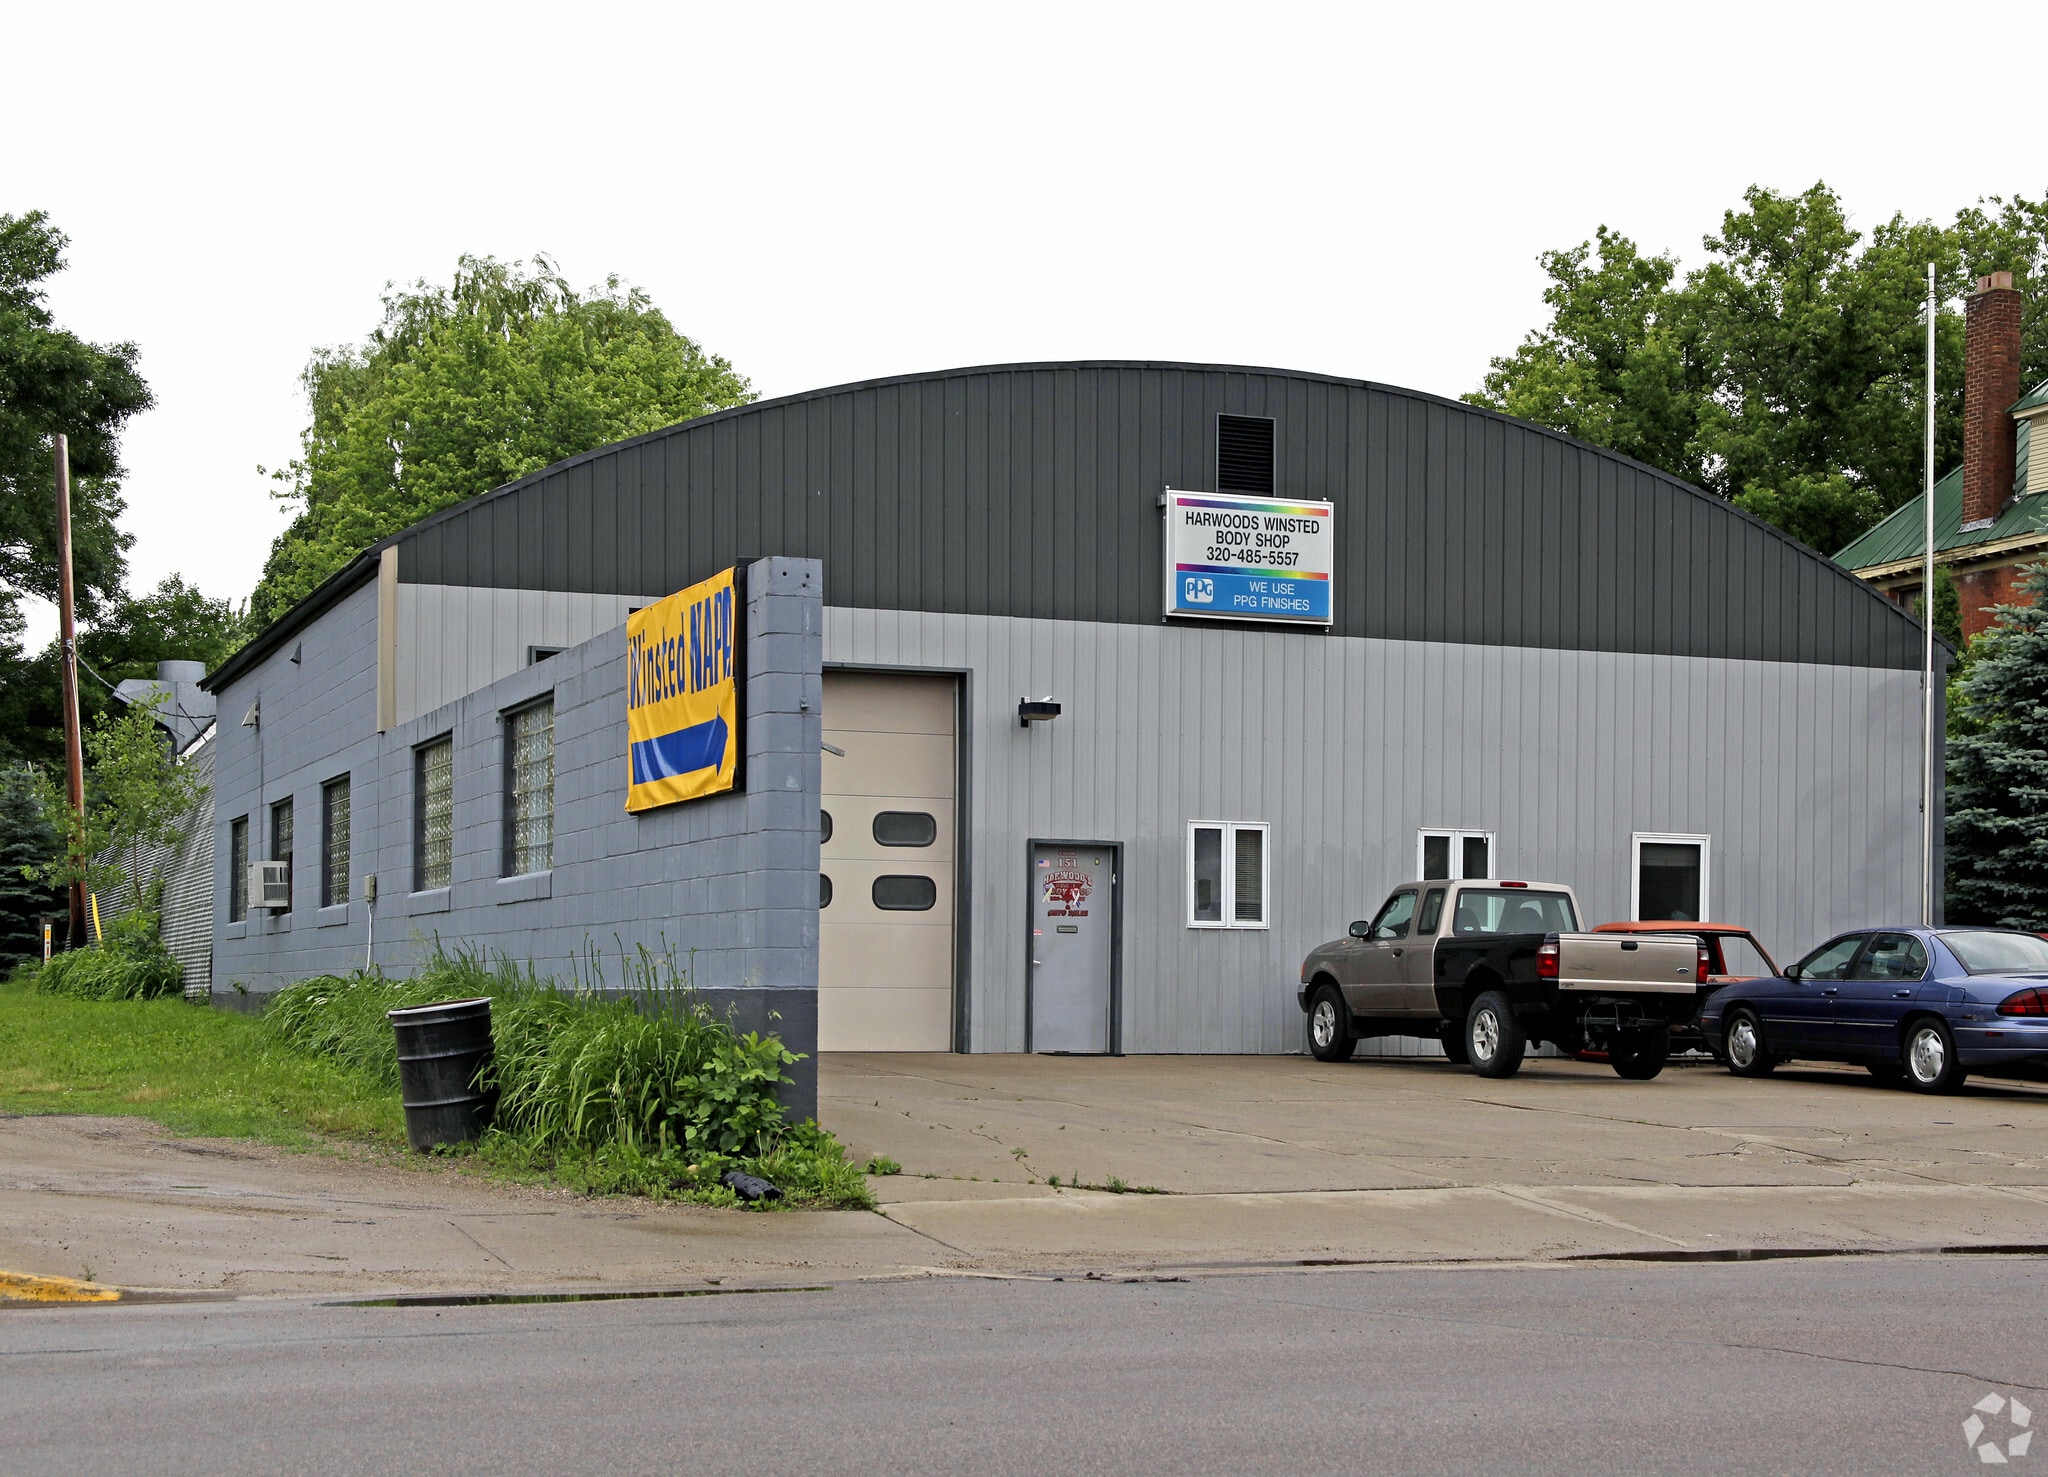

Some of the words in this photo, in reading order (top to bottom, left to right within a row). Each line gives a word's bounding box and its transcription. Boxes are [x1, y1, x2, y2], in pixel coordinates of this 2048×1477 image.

[1185, 511, 1259, 531] HARWOODS
[1264, 517, 1320, 534] WINSTED
[1216, 531, 1251, 546] BODY
[1255, 533, 1290, 548] SHOP
[1206, 547, 1299, 566] 320-485-5557
[1249, 581, 1268, 594] WE
[1272, 583, 1295, 595] USE
[1234, 595, 1257, 608] PPG
[1261, 597, 1310, 611] FINISHES
[629, 612, 685, 710] Winsted
[690, 586, 732, 694] NAPA
[1057, 858, 1078, 868] 151
